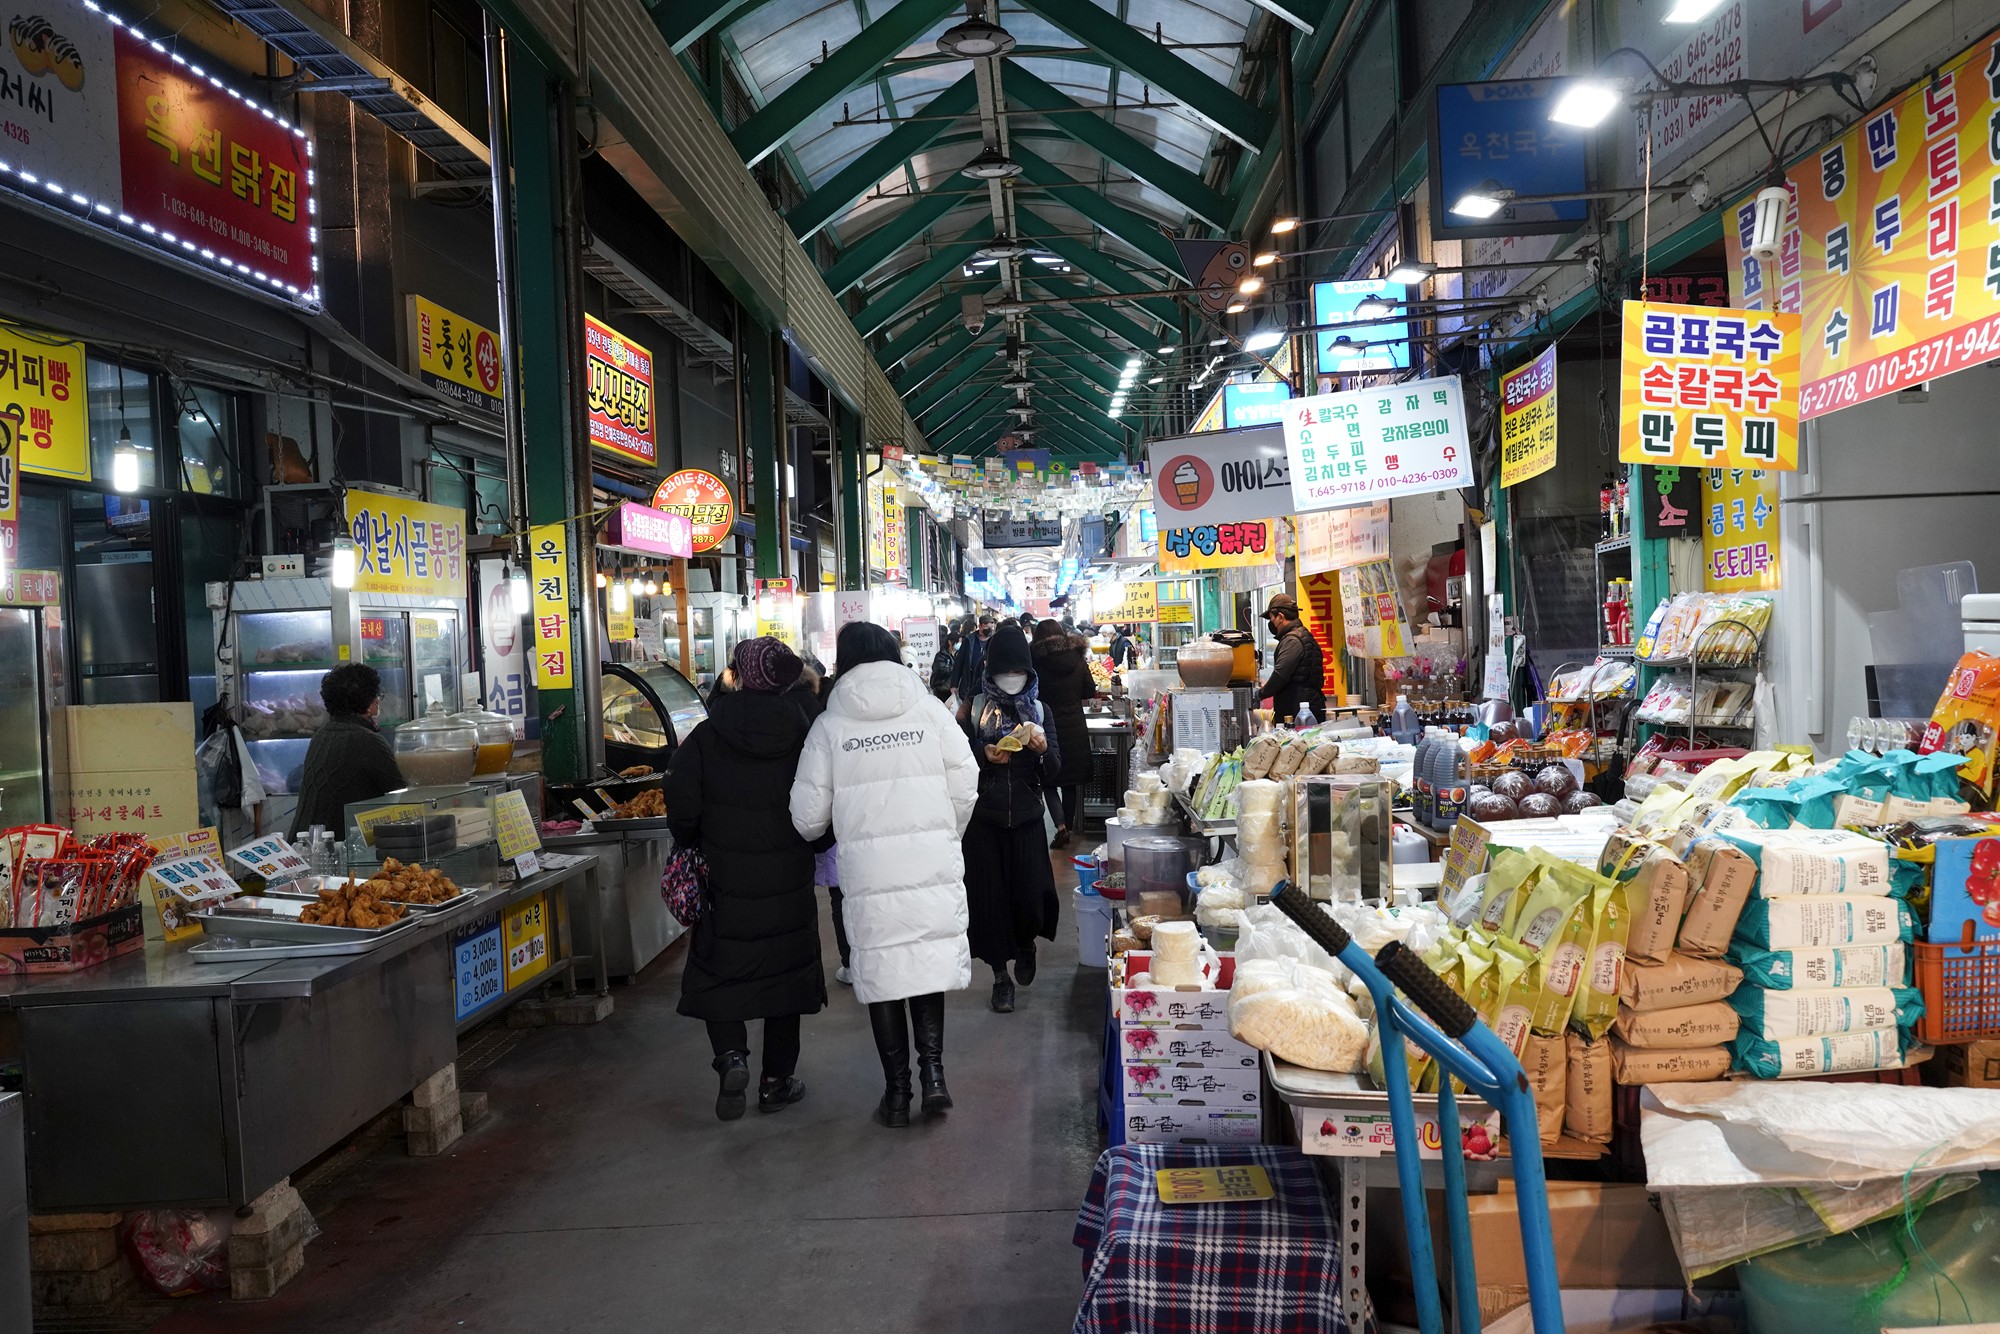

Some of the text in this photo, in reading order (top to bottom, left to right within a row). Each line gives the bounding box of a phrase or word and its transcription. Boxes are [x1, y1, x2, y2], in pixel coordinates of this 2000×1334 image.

[145, 95, 297, 223] 옥천닭집
[1925, 73, 1959, 320] 도토리묵
[1868, 112, 1899, 336] 만두피
[1823, 145, 1850, 356] 콩국수
[420, 312, 432, 361] 잡곡
[436, 318, 473, 380] 통일
[1645, 315, 1781, 361] 곰표국수
[589, 355, 650, 434] 꼬꼬닭집
[1506, 359, 1553, 406] 옥천국수 공장
[1642, 365, 1781, 408] 손칼국수
[1381, 418, 1450, 443] 감자옹심이
[1642, 413, 1777, 458] 만두피
[1305, 459, 1368, 482] 김치만두
[1309, 480, 1366, 498] T.645-9718
[1377, 467, 1459, 489] 010-4236-0309
[1712, 495, 1767, 535] 콩국수
[352, 507, 464, 582] 옛날시골통닭
[1166, 521, 1267, 558] 삼양닭집
[1713, 543, 1768, 579] 도토리묵
[23, 574, 53, 597] 국내산
[361, 620, 383, 637] 국내산
[533, 538, 566, 678] 옥천닭집
[865, 741, 916, 753] EXPEDITION
[472, 936, 497, 960] 3,000원
[473, 957, 498, 981] 4,000원
[474, 978, 498, 1003] 5,000원
